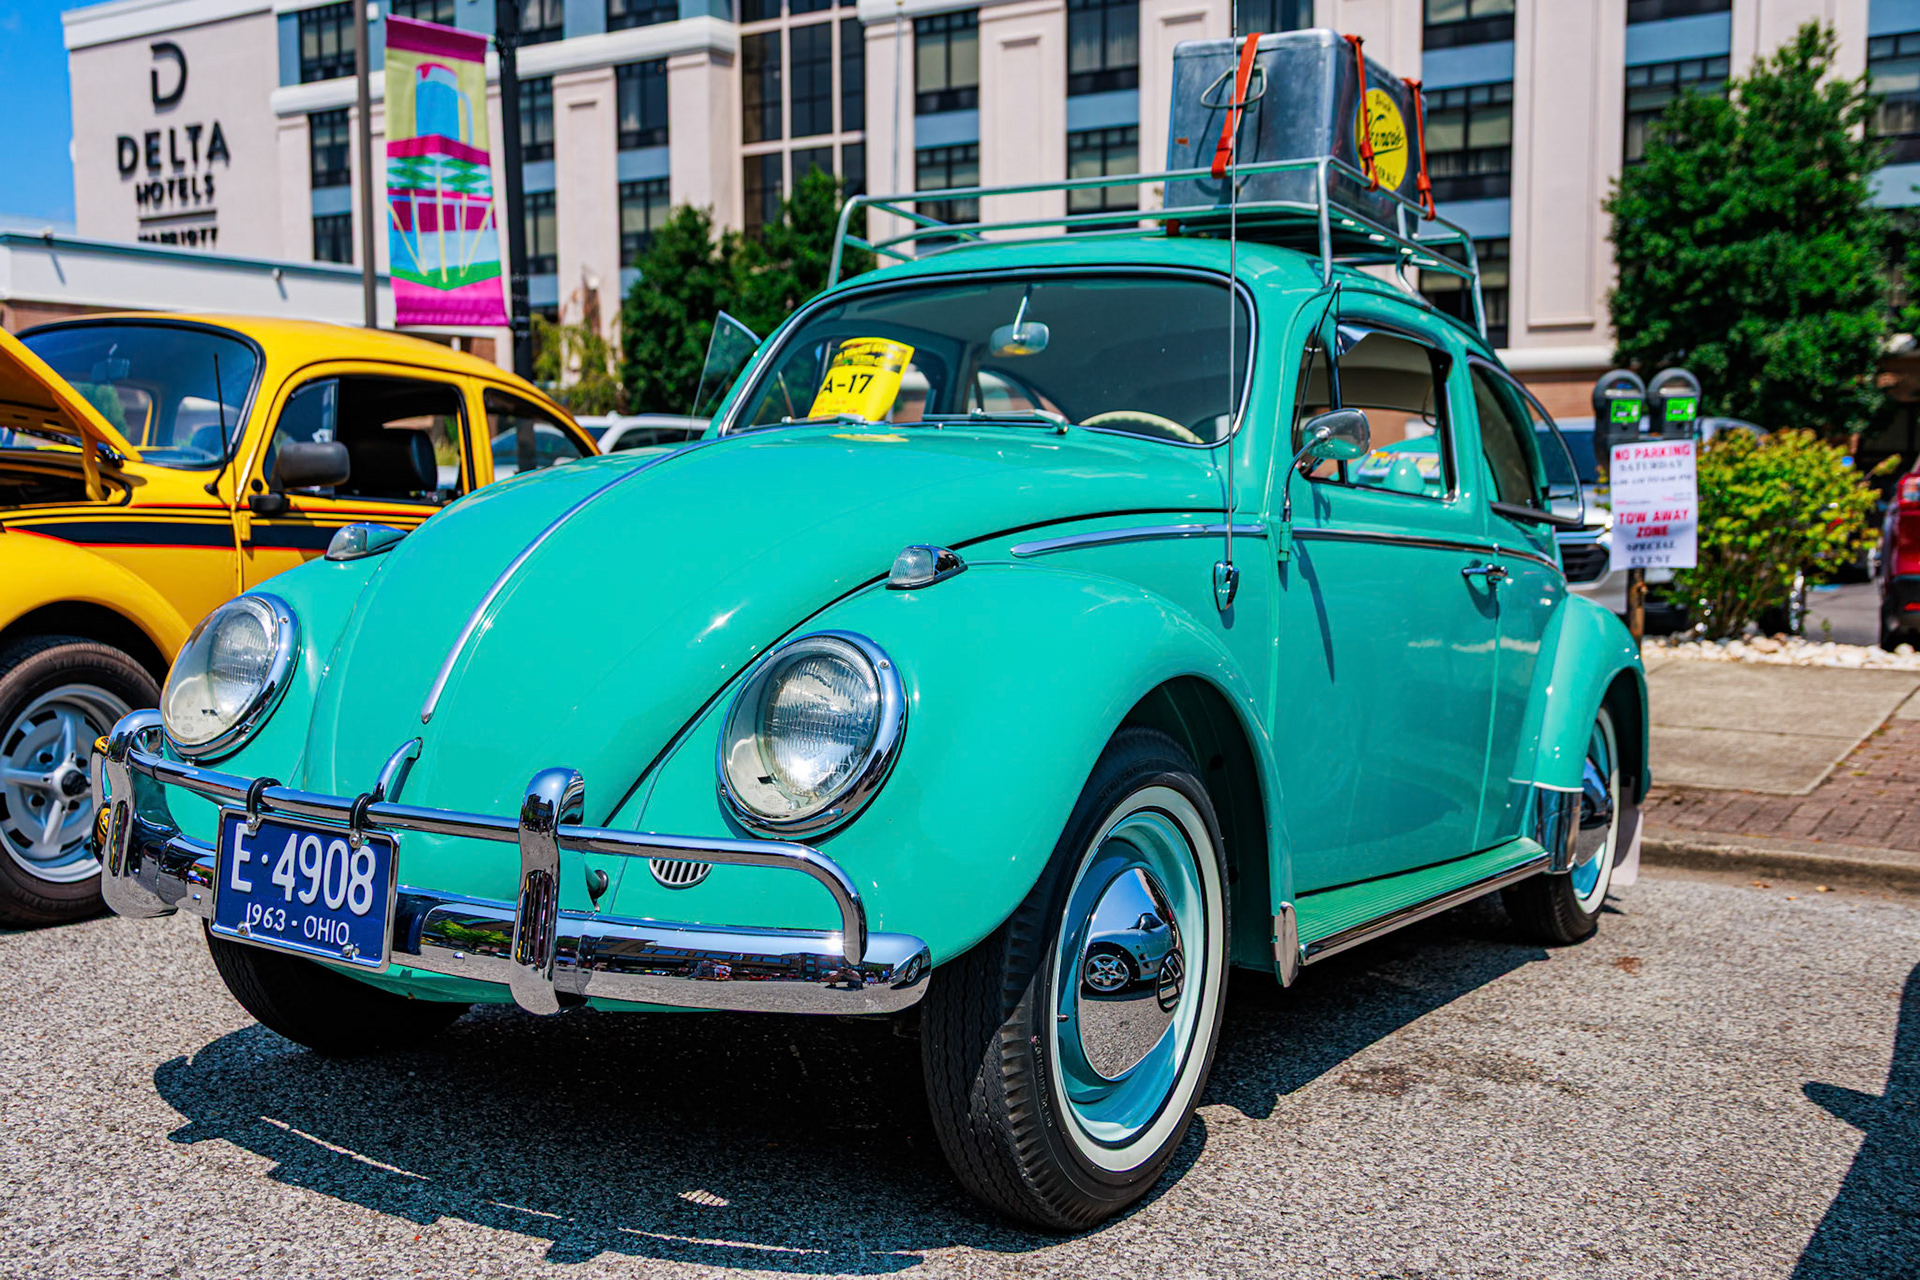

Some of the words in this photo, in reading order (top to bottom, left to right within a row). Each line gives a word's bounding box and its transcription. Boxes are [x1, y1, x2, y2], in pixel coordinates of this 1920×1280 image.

[116, 121, 230, 175] DELTA
[136, 174, 215, 206] HOTELS
[822, 374, 875, 394] A-17
[1614, 449, 1630, 461] NO
[1635, 444, 1691, 458] PARKING
[1619, 511, 1647, 525] TOW
[1652, 509, 1689, 522] AWAY
[1636, 525, 1668, 538] ZONE
[1626, 541, 1675, 551] SPECIAL
[1630, 554, 1671, 564] EVENT
[246, 902, 286, 932] 1963
[303, 915, 350, 946] OHIO
